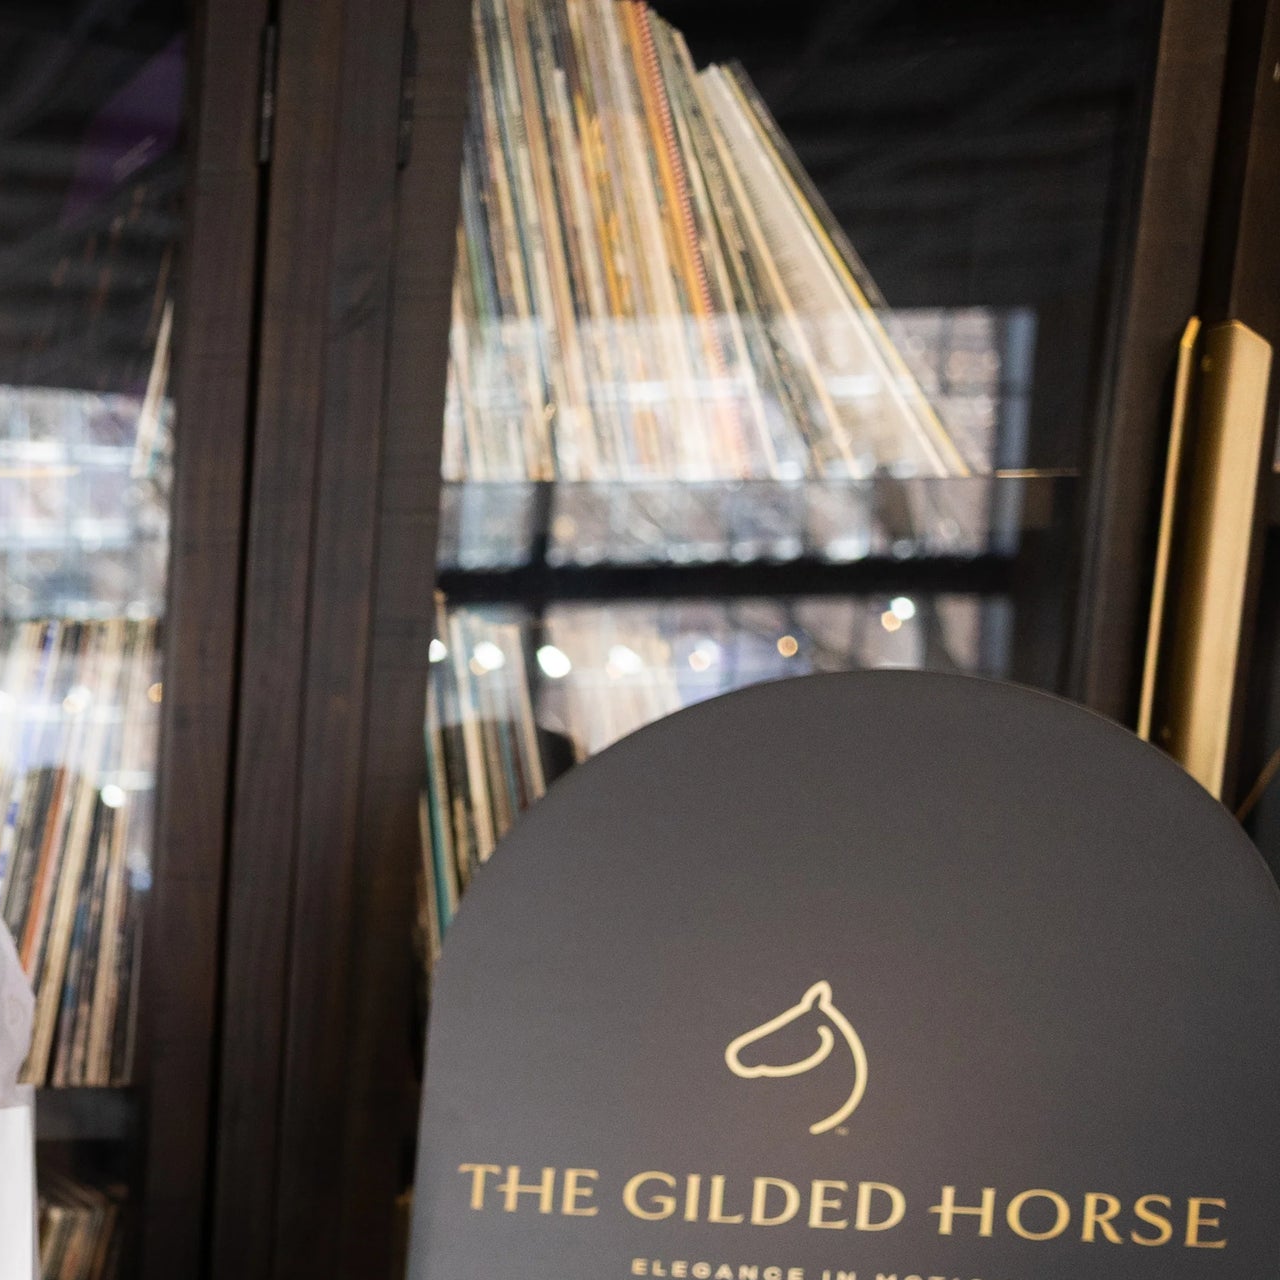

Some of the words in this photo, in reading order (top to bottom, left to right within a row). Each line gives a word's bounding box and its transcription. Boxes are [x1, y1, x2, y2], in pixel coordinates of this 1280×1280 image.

[457, 1162, 600, 1217] THE
[622, 1170, 906, 1232] GILDED
[927, 1184, 1228, 1250] HORSE
